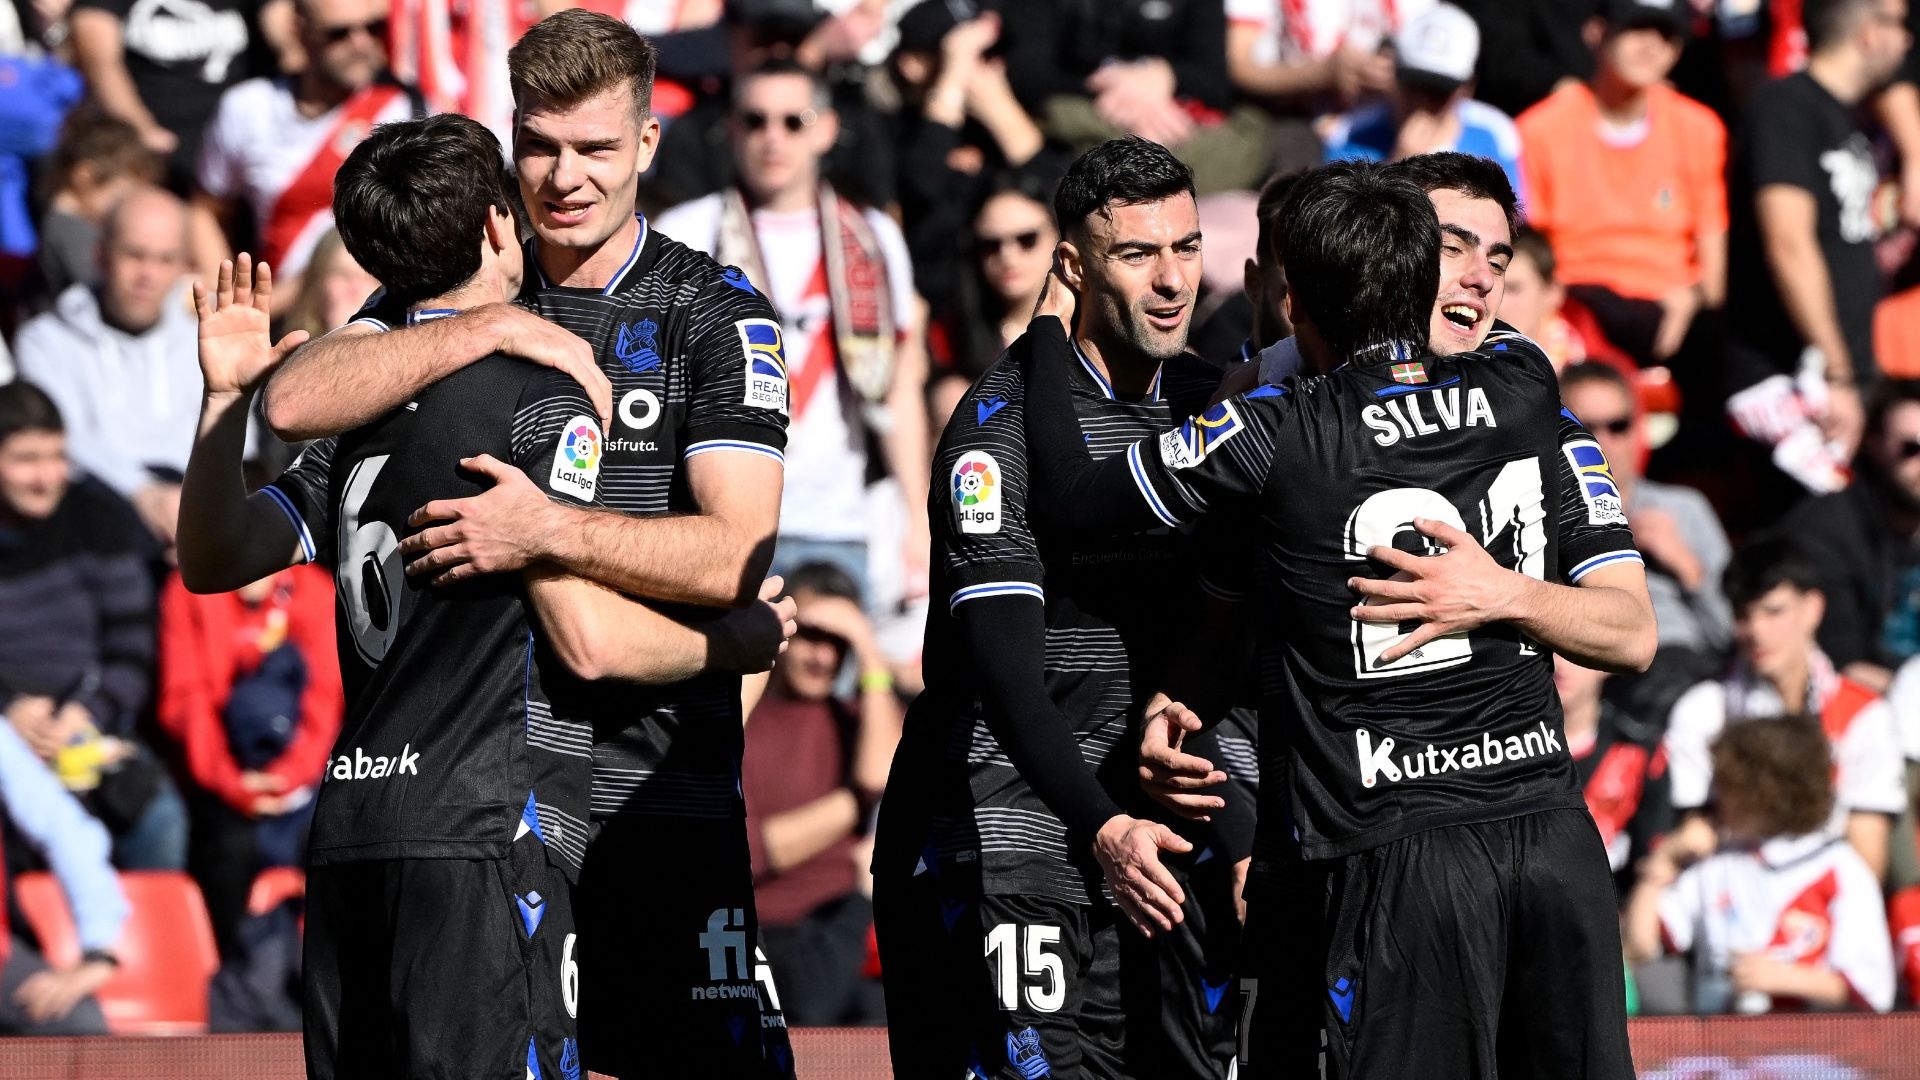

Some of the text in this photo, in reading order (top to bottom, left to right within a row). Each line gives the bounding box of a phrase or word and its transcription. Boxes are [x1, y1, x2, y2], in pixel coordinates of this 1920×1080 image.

[1361, 387, 1497, 446] SILVA
[557, 468, 593, 490] LaLiga
[958, 508, 995, 523] aLiga
[337, 454, 404, 669] 6
[1343, 456, 1548, 679] 21
[1355, 720, 1562, 789] Kutxabank
[561, 932, 579, 1019] 6
[699, 908, 749, 981] fi
[984, 923, 1066, 1013] 15
[691, 982, 759, 1000] network
